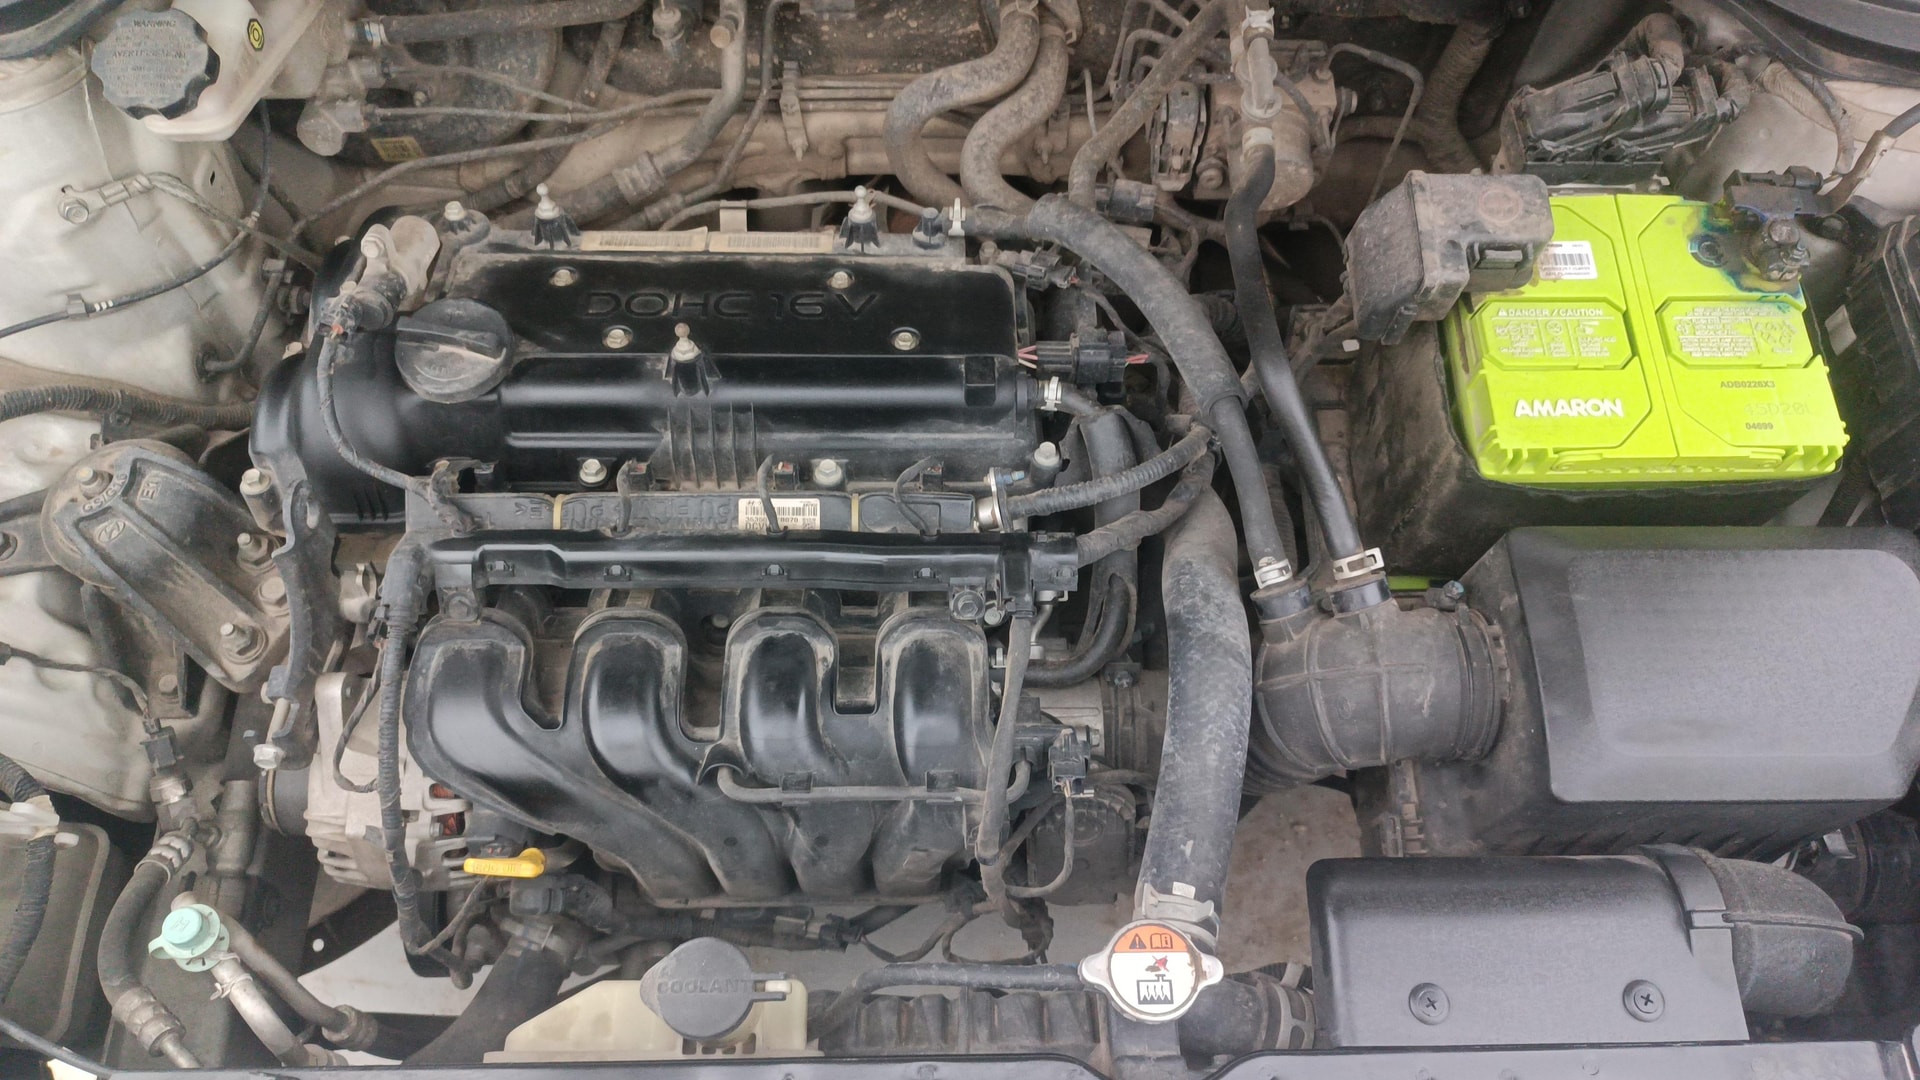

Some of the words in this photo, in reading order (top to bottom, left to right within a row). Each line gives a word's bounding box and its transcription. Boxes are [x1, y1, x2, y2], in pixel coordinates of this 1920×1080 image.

[133, 19, 177, 28] WARNING
[584, 291, 749, 319] DOHC
[1508, 308, 1550, 317] DANGER
[1514, 397, 1625, 419] AMARON
[657, 979, 750, 994] COOLANT
